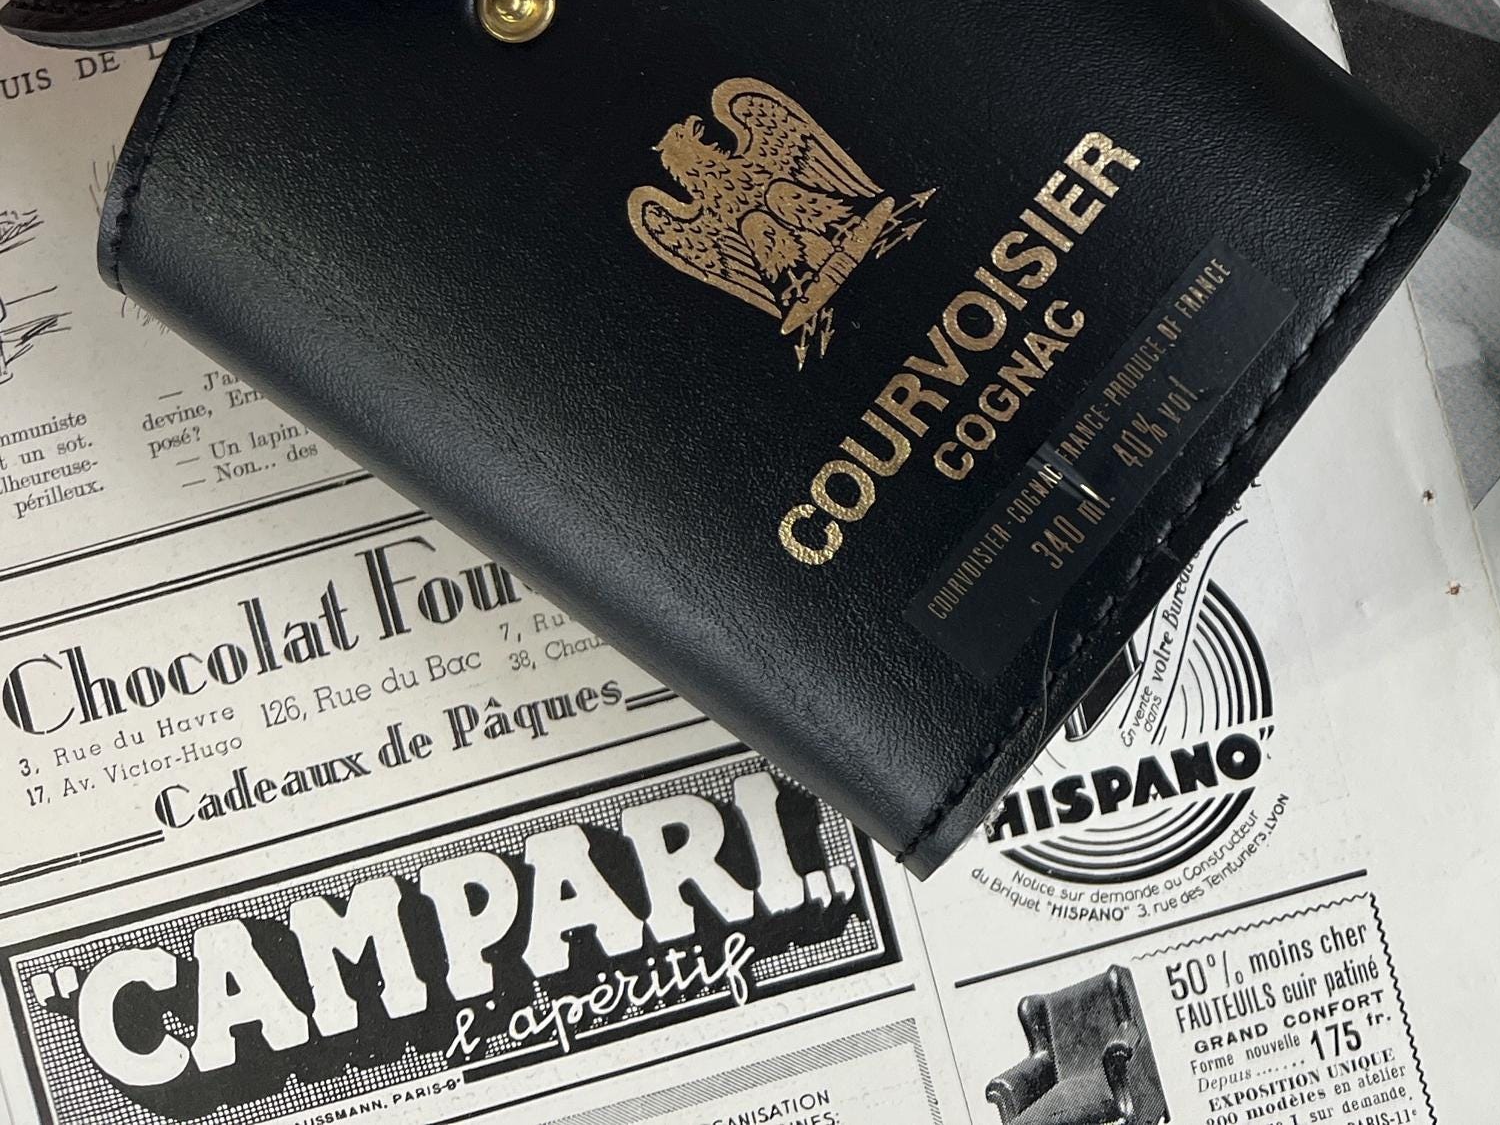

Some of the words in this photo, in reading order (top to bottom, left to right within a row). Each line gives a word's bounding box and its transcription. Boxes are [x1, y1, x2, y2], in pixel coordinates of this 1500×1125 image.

[777, 131, 1141, 566] COURVOISIER
[933, 299, 1085, 480] COGNAC
[928, 527, 1012, 621] COURVOISIER
[1156, 315, 1182, 340] OF
[1174, 258, 1231, 319] FRANCE
[13, 480, 105, 520] périlleux.
[1030, 513, 1086, 571] 340
[2, 579, 360, 735] Chocolat
[356, 535, 521, 641] Fou
[260, 695, 307, 729] 126,
[312, 683, 372, 714] Rue
[381, 666, 420, 694] du
[424, 651, 482, 682] Bac
[18, 758, 40, 777] 3,
[53, 743, 102, 767] Rue
[114, 730, 145, 750] du
[156, 706, 235, 739] Havre
[63, 777, 96, 798] Av.
[102, 737, 243, 784] Victor-Hugo
[154, 751, 372, 829] Cadeaux
[378, 722, 433, 768] de
[442, 679, 623, 751] Pâques
[971, 868, 988, 883] du
[989, 879, 1041, 913] Briquet
[1153, 899, 1178, 916] rue
[1181, 885, 1205, 904] des
[1269, 793, 1290, 831] LYON
[1061, 888, 1085, 902] sur
[1090, 884, 1161, 904] demande
[1164, 876, 1183, 891] au
[1183, 810, 1259, 880] Constructeur
[1165, 950, 1244, 1001] 50%
[1248, 939, 1314, 974] moins
[1320, 924, 1367, 954] cher
[1175, 982, 1277, 1034] FAUTEUILS
[1282, 972, 1317, 1004] cuir
[1323, 954, 1379, 998] patiné
[1194, 1023, 1268, 1054] GRAND
[1283, 989, 1384, 1029] CONFORT
[1310, 1020, 1362, 1061] 175
[1366, 1012, 1391, 1027] fr.
